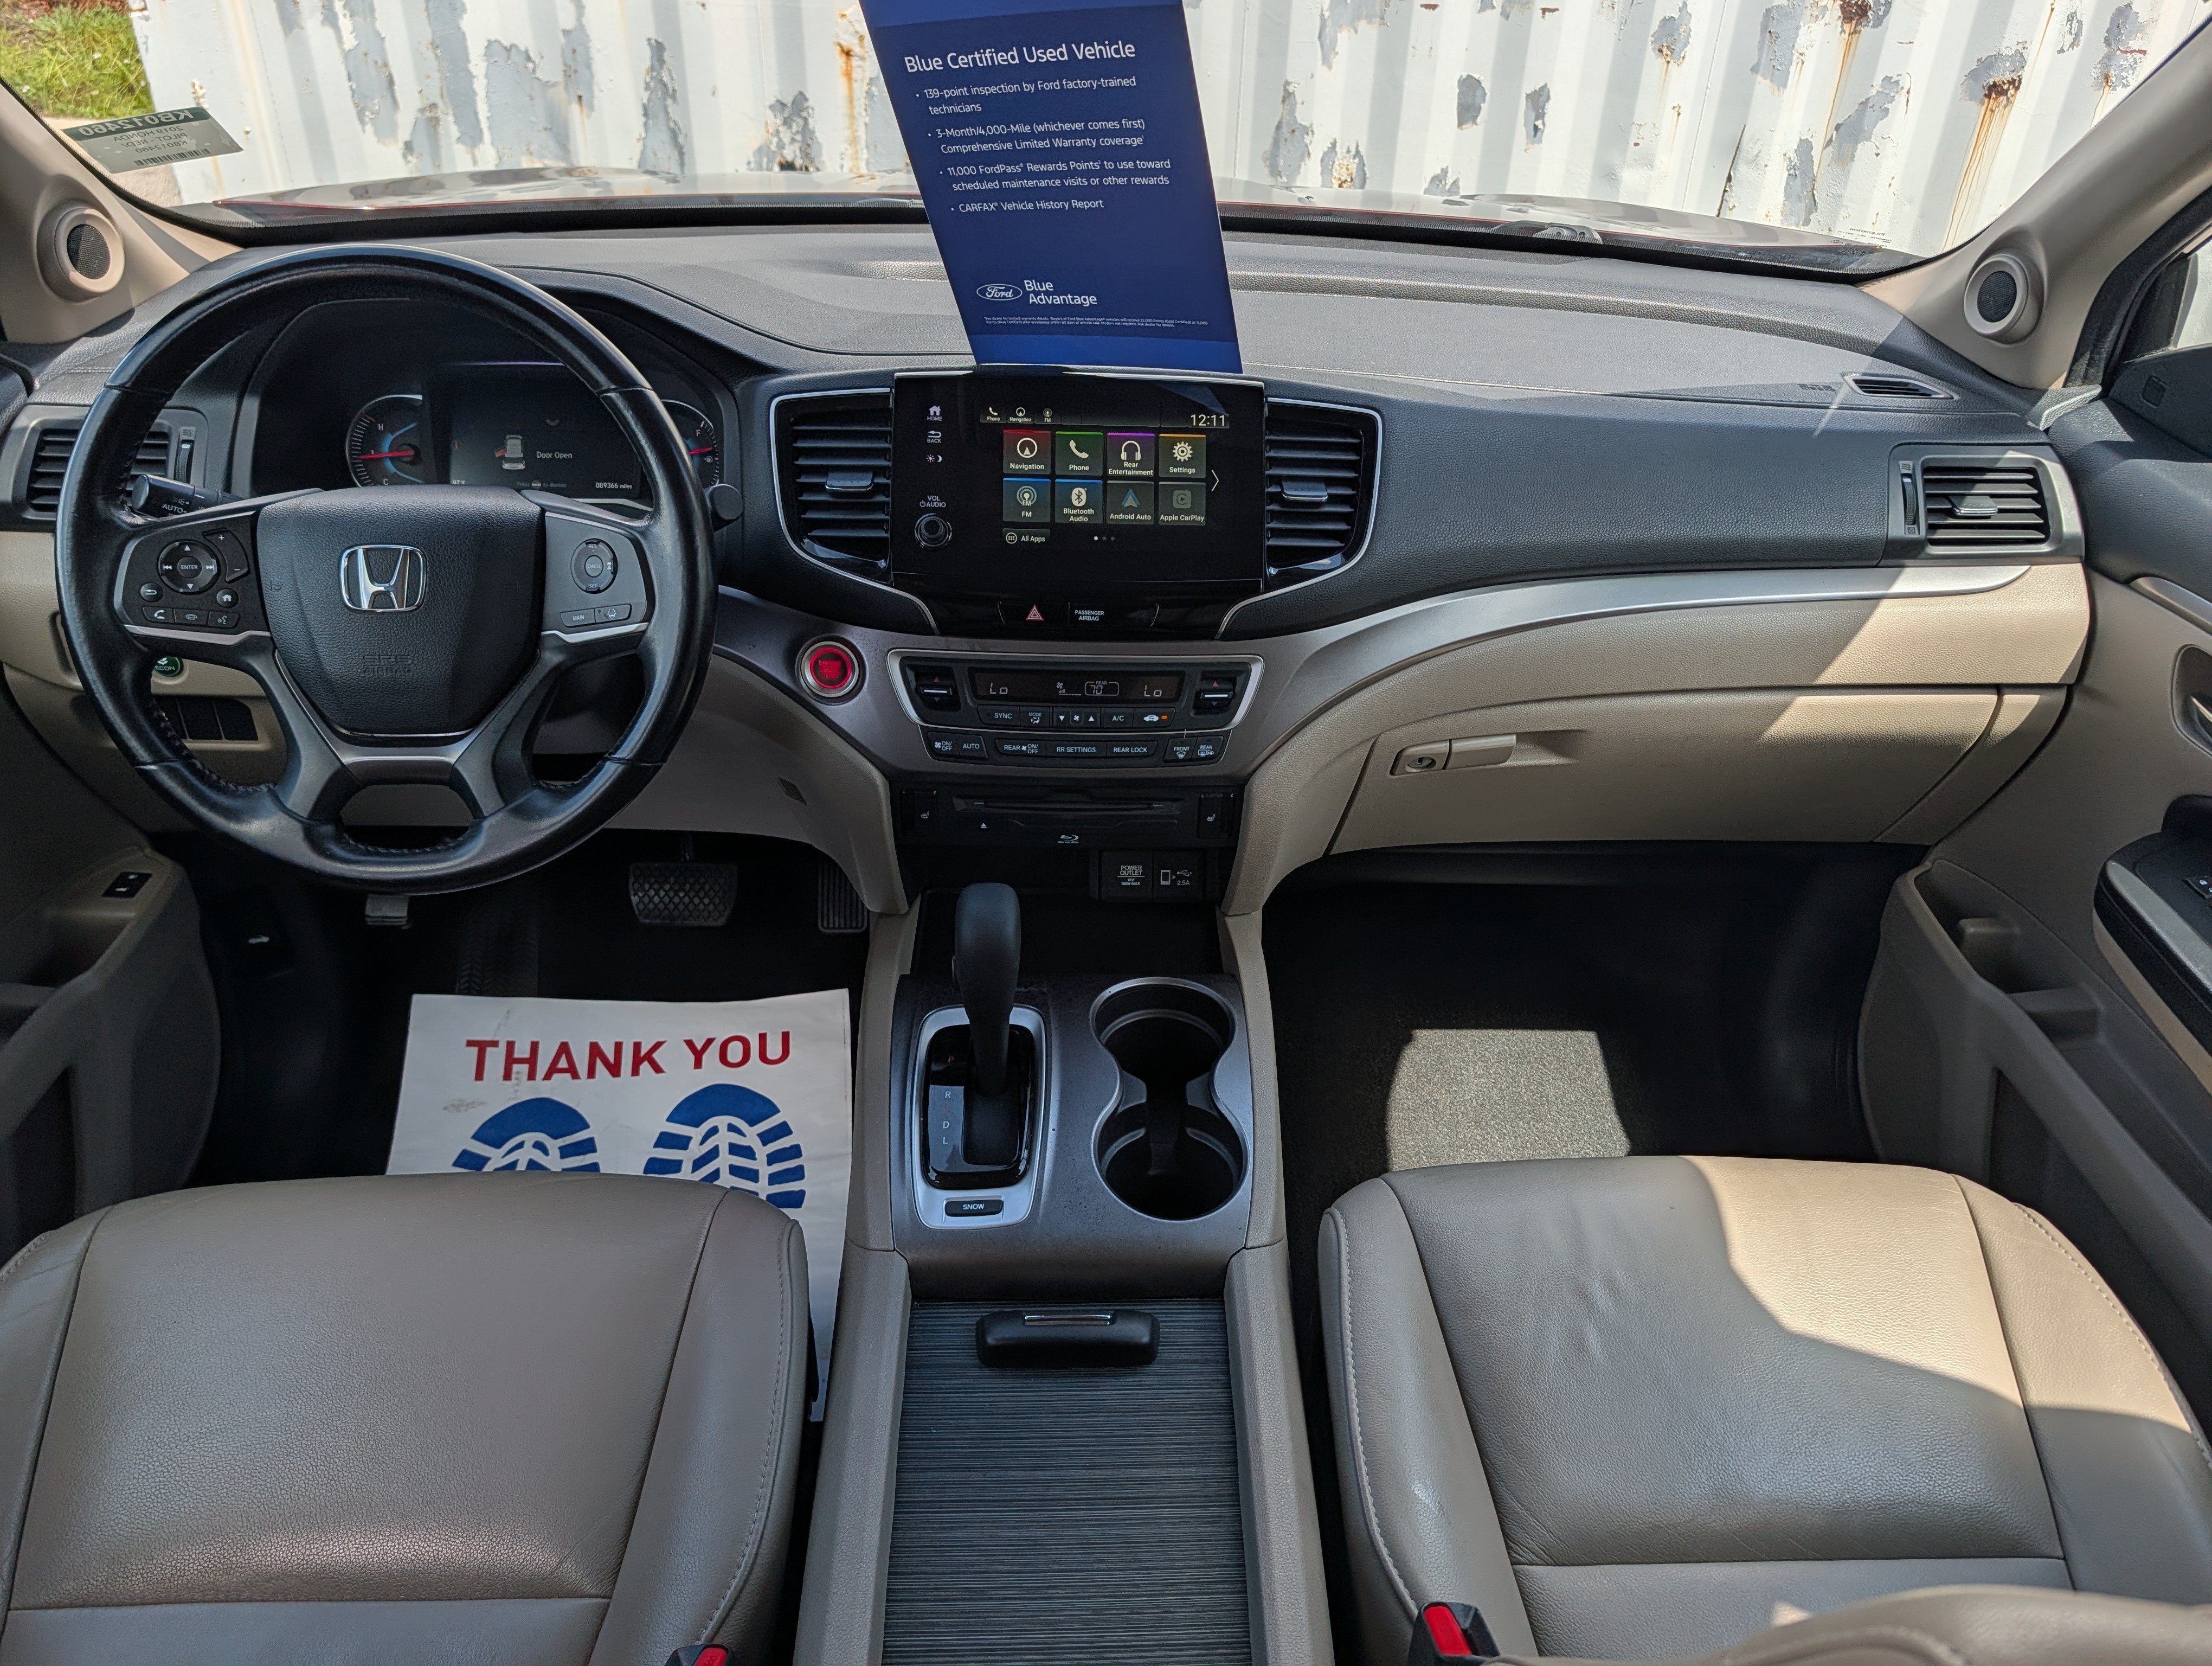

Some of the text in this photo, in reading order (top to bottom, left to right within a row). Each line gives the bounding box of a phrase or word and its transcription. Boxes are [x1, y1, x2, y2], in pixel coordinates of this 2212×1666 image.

[904, 40, 1136, 72] Blue Certified Used Vehicle
[924, 76, 1136, 99] 139-point inspection by Ford factory-trained
[929, 102, 982, 115] technicians
[1033, 121, 1085, 134] (whichever
[1088, 121, 1120, 130] comes
[1122, 119, 1145, 130] first)
[941, 141, 1013, 153] Comprehensive
[1014, 138, 1050, 149] Limited
[1052, 137, 1096, 148] Warranty
[947, 166, 976, 176] 11,000
[1026, 161, 1068, 172] Rewards
[1104, 161, 1114, 169] to
[1117, 161, 1134, 169] use
[1136, 159, 1171, 169] toward
[953, 180, 999, 190] scheduled
[1002, 178, 1061, 188] maintenance
[1063, 176, 1088, 186] visits
[1103, 176, 1128, 185] other
[1131, 175, 1169, 184] rewards
[1000, 201, 1034, 211] Vehicle
[1036, 200, 1069, 210] History
[1071, 200, 1104, 210] Report
[986, 285, 1014, 299] Ford
[1024, 280, 1053, 291] Blue
[1029, 293, 1097, 306] Advantage
[1191, 414, 1225, 427] 12:11
[555, 451, 573, 459] Open
[162, 503, 184, 514] AUTO
[466, 1030, 791, 1082] THANK YOU
